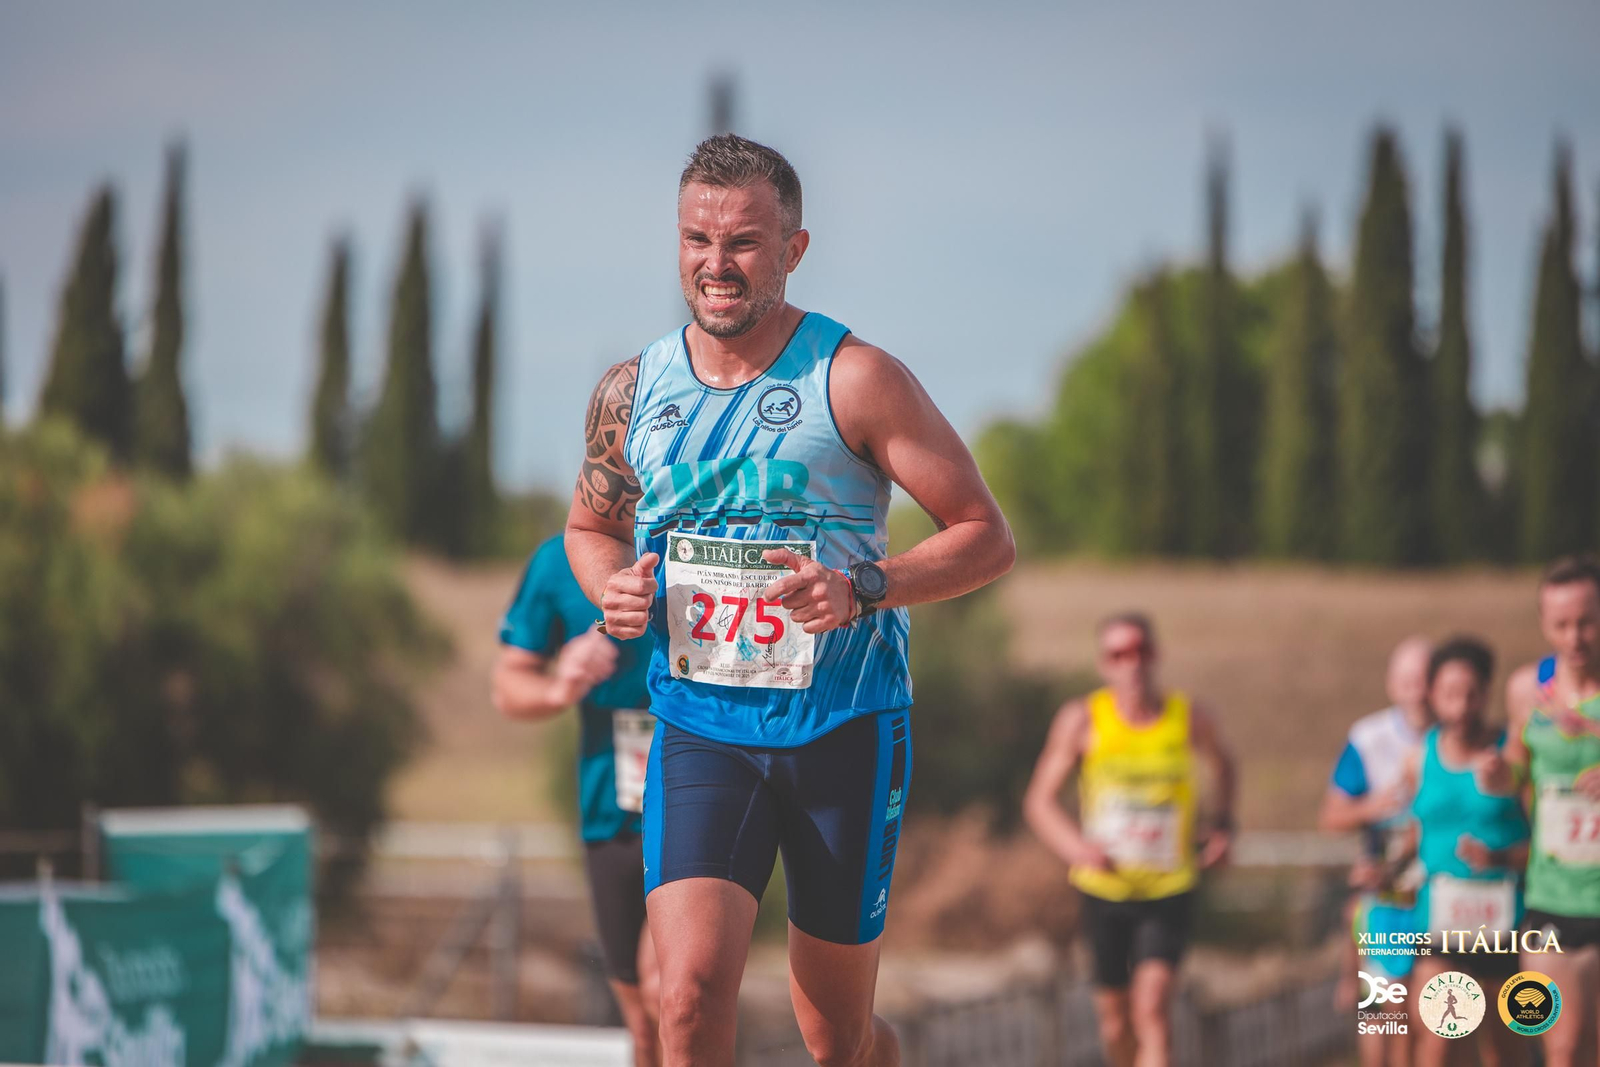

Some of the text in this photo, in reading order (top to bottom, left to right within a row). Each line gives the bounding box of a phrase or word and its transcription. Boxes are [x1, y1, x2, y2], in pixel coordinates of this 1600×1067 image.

[650, 419, 689, 433] austral
[752, 416, 761, 427] Los
[760, 423, 776, 433] niños
[786, 419, 803, 431] barrio
[697, 569, 712, 577] IVÁN
[712, 571, 740, 580] MIRANDA
[714, 579, 732, 587] NIÑOS
[691, 593, 785, 645] 275
